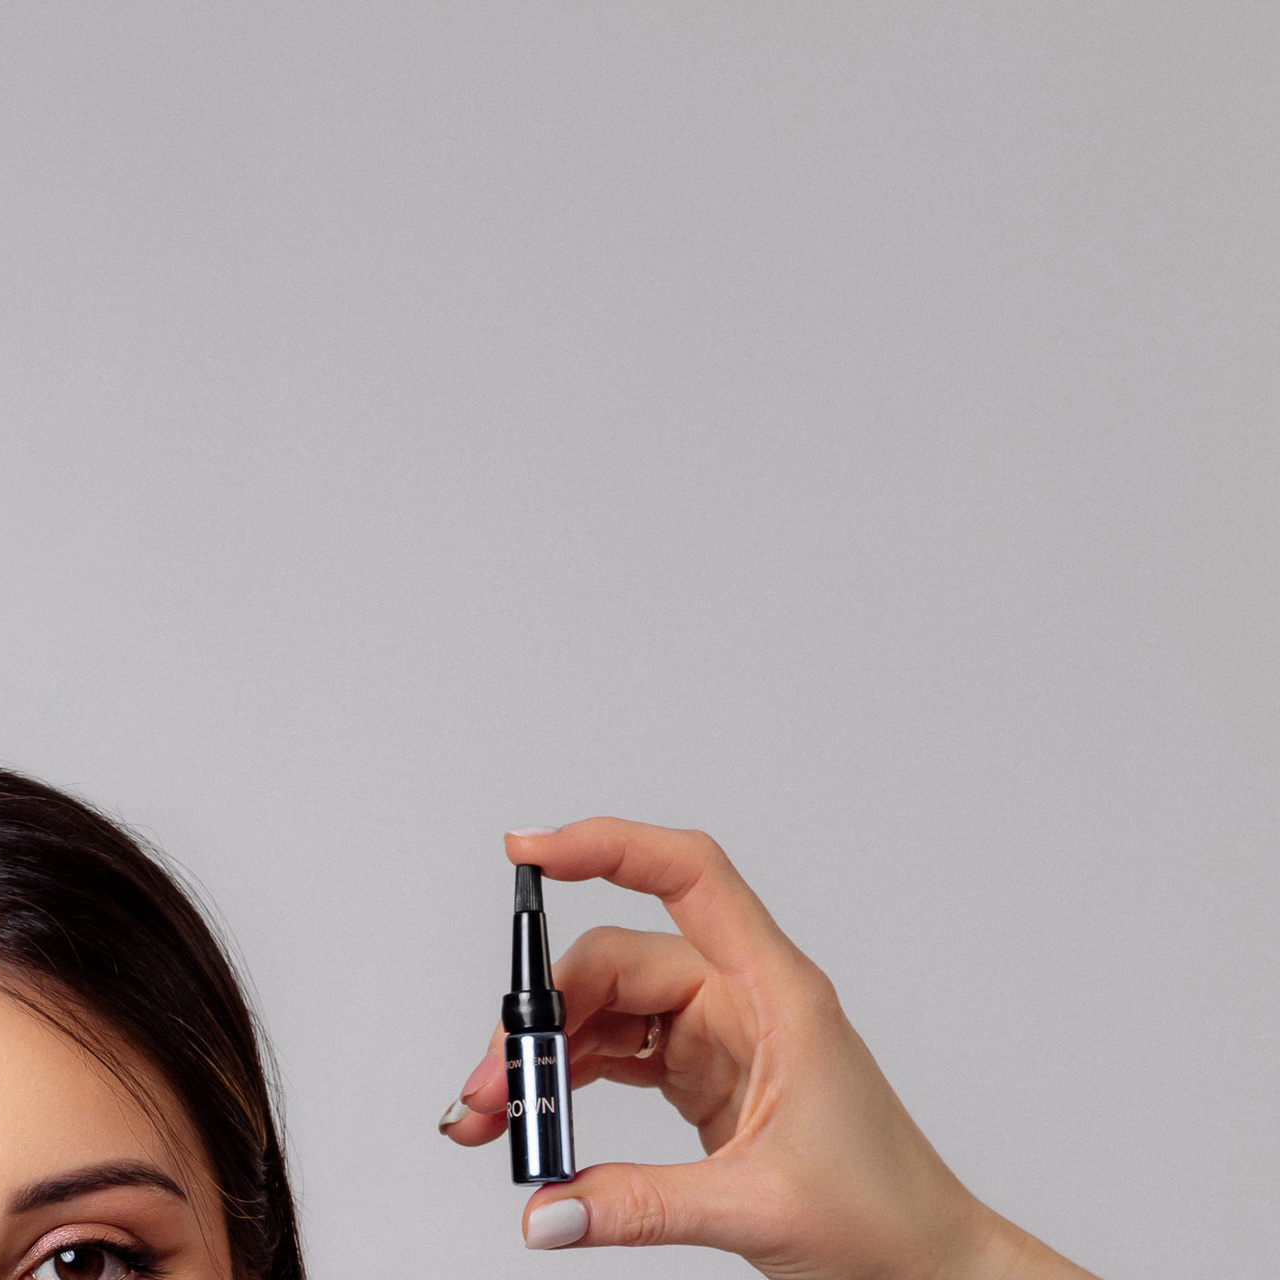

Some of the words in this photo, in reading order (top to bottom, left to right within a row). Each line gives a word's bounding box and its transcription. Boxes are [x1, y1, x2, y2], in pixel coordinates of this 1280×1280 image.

[505, 1059, 523, 1070] ROW
[525, 1056, 557, 1066] ENNA
[506, 1096, 555, 1118] ROWN
